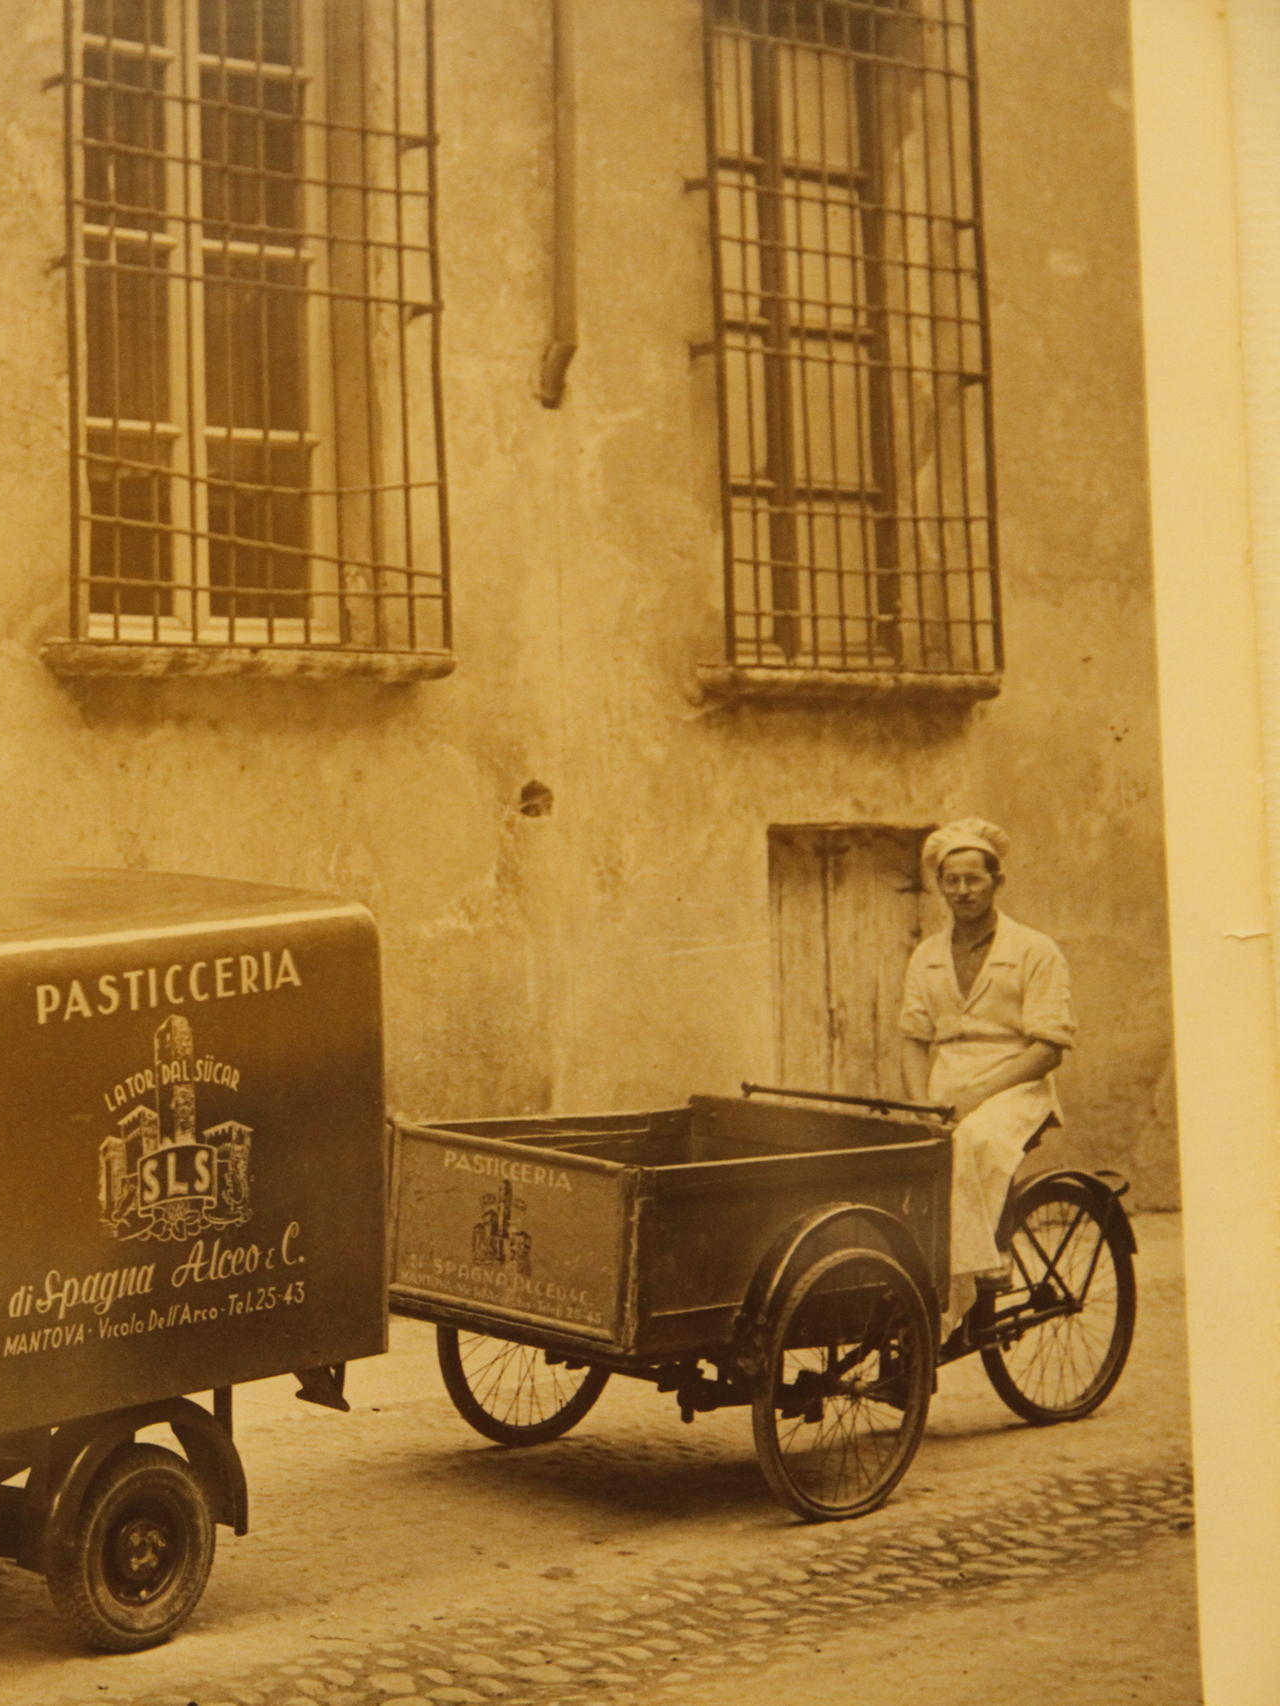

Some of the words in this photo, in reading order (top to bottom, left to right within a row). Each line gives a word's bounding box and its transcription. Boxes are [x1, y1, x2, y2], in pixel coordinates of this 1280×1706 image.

[36, 948, 302, 1025] PASTICCERIA
[124, 1068, 156, 1099] TOR
[161, 1059, 190, 1086] DAL
[193, 1053, 241, 1093] SÜCAR
[142, 1149, 211, 1204] SLS
[443, 1150, 572, 1191] PASTICCERIA
[8, 1285, 34, 1318] di
[35, 1262, 157, 1320] Spagna
[171, 1238, 262, 1288] Alceo
[281, 1221, 305, 1266] C.
[433, 1258, 508, 1289] SPAGNA
[3, 1322, 85, 1358] MANTOVA
[99, 1312, 145, 1340] Vicolo
